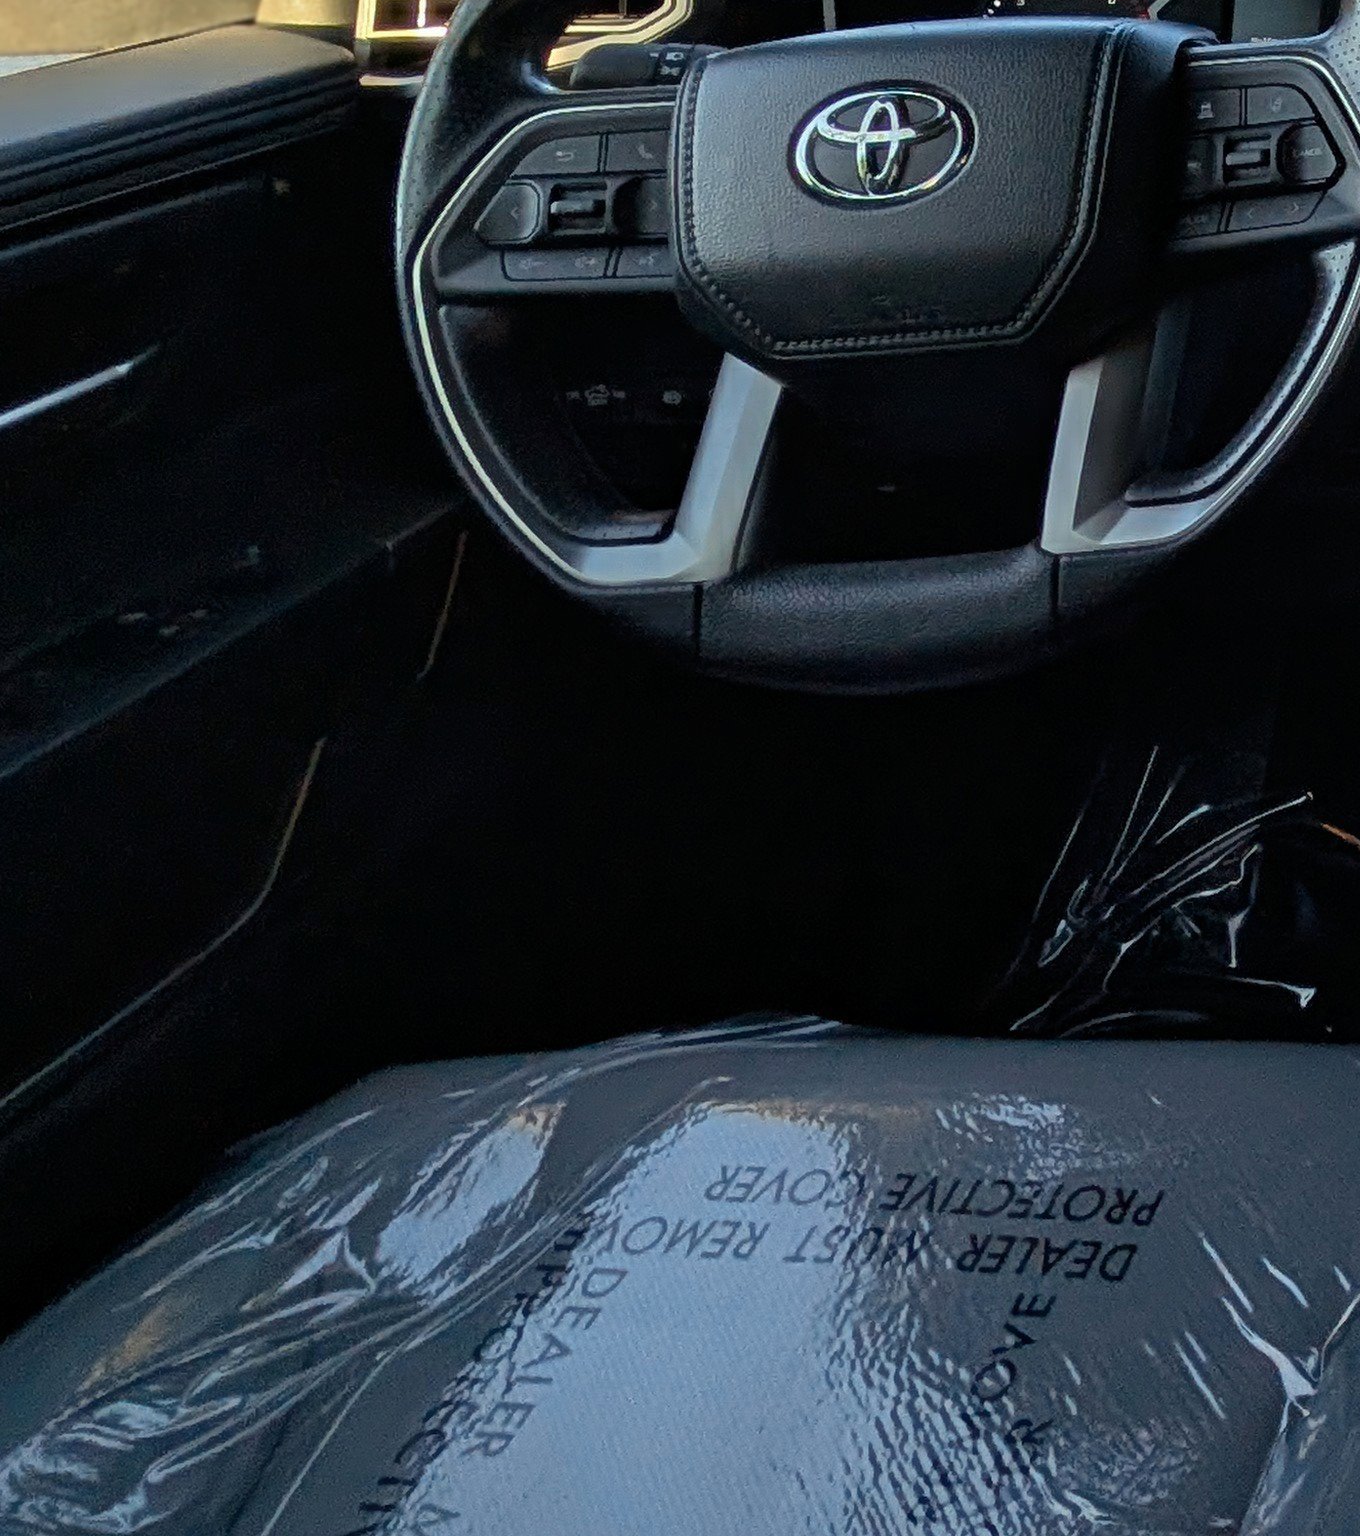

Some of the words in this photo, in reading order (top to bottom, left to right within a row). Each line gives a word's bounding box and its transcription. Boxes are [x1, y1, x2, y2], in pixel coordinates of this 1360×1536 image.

[879, 1170, 1165, 1228] PROTECTIVE
[954, 1232, 1139, 1284] DEALER
[460, 1266, 629, 1458] DEALER
